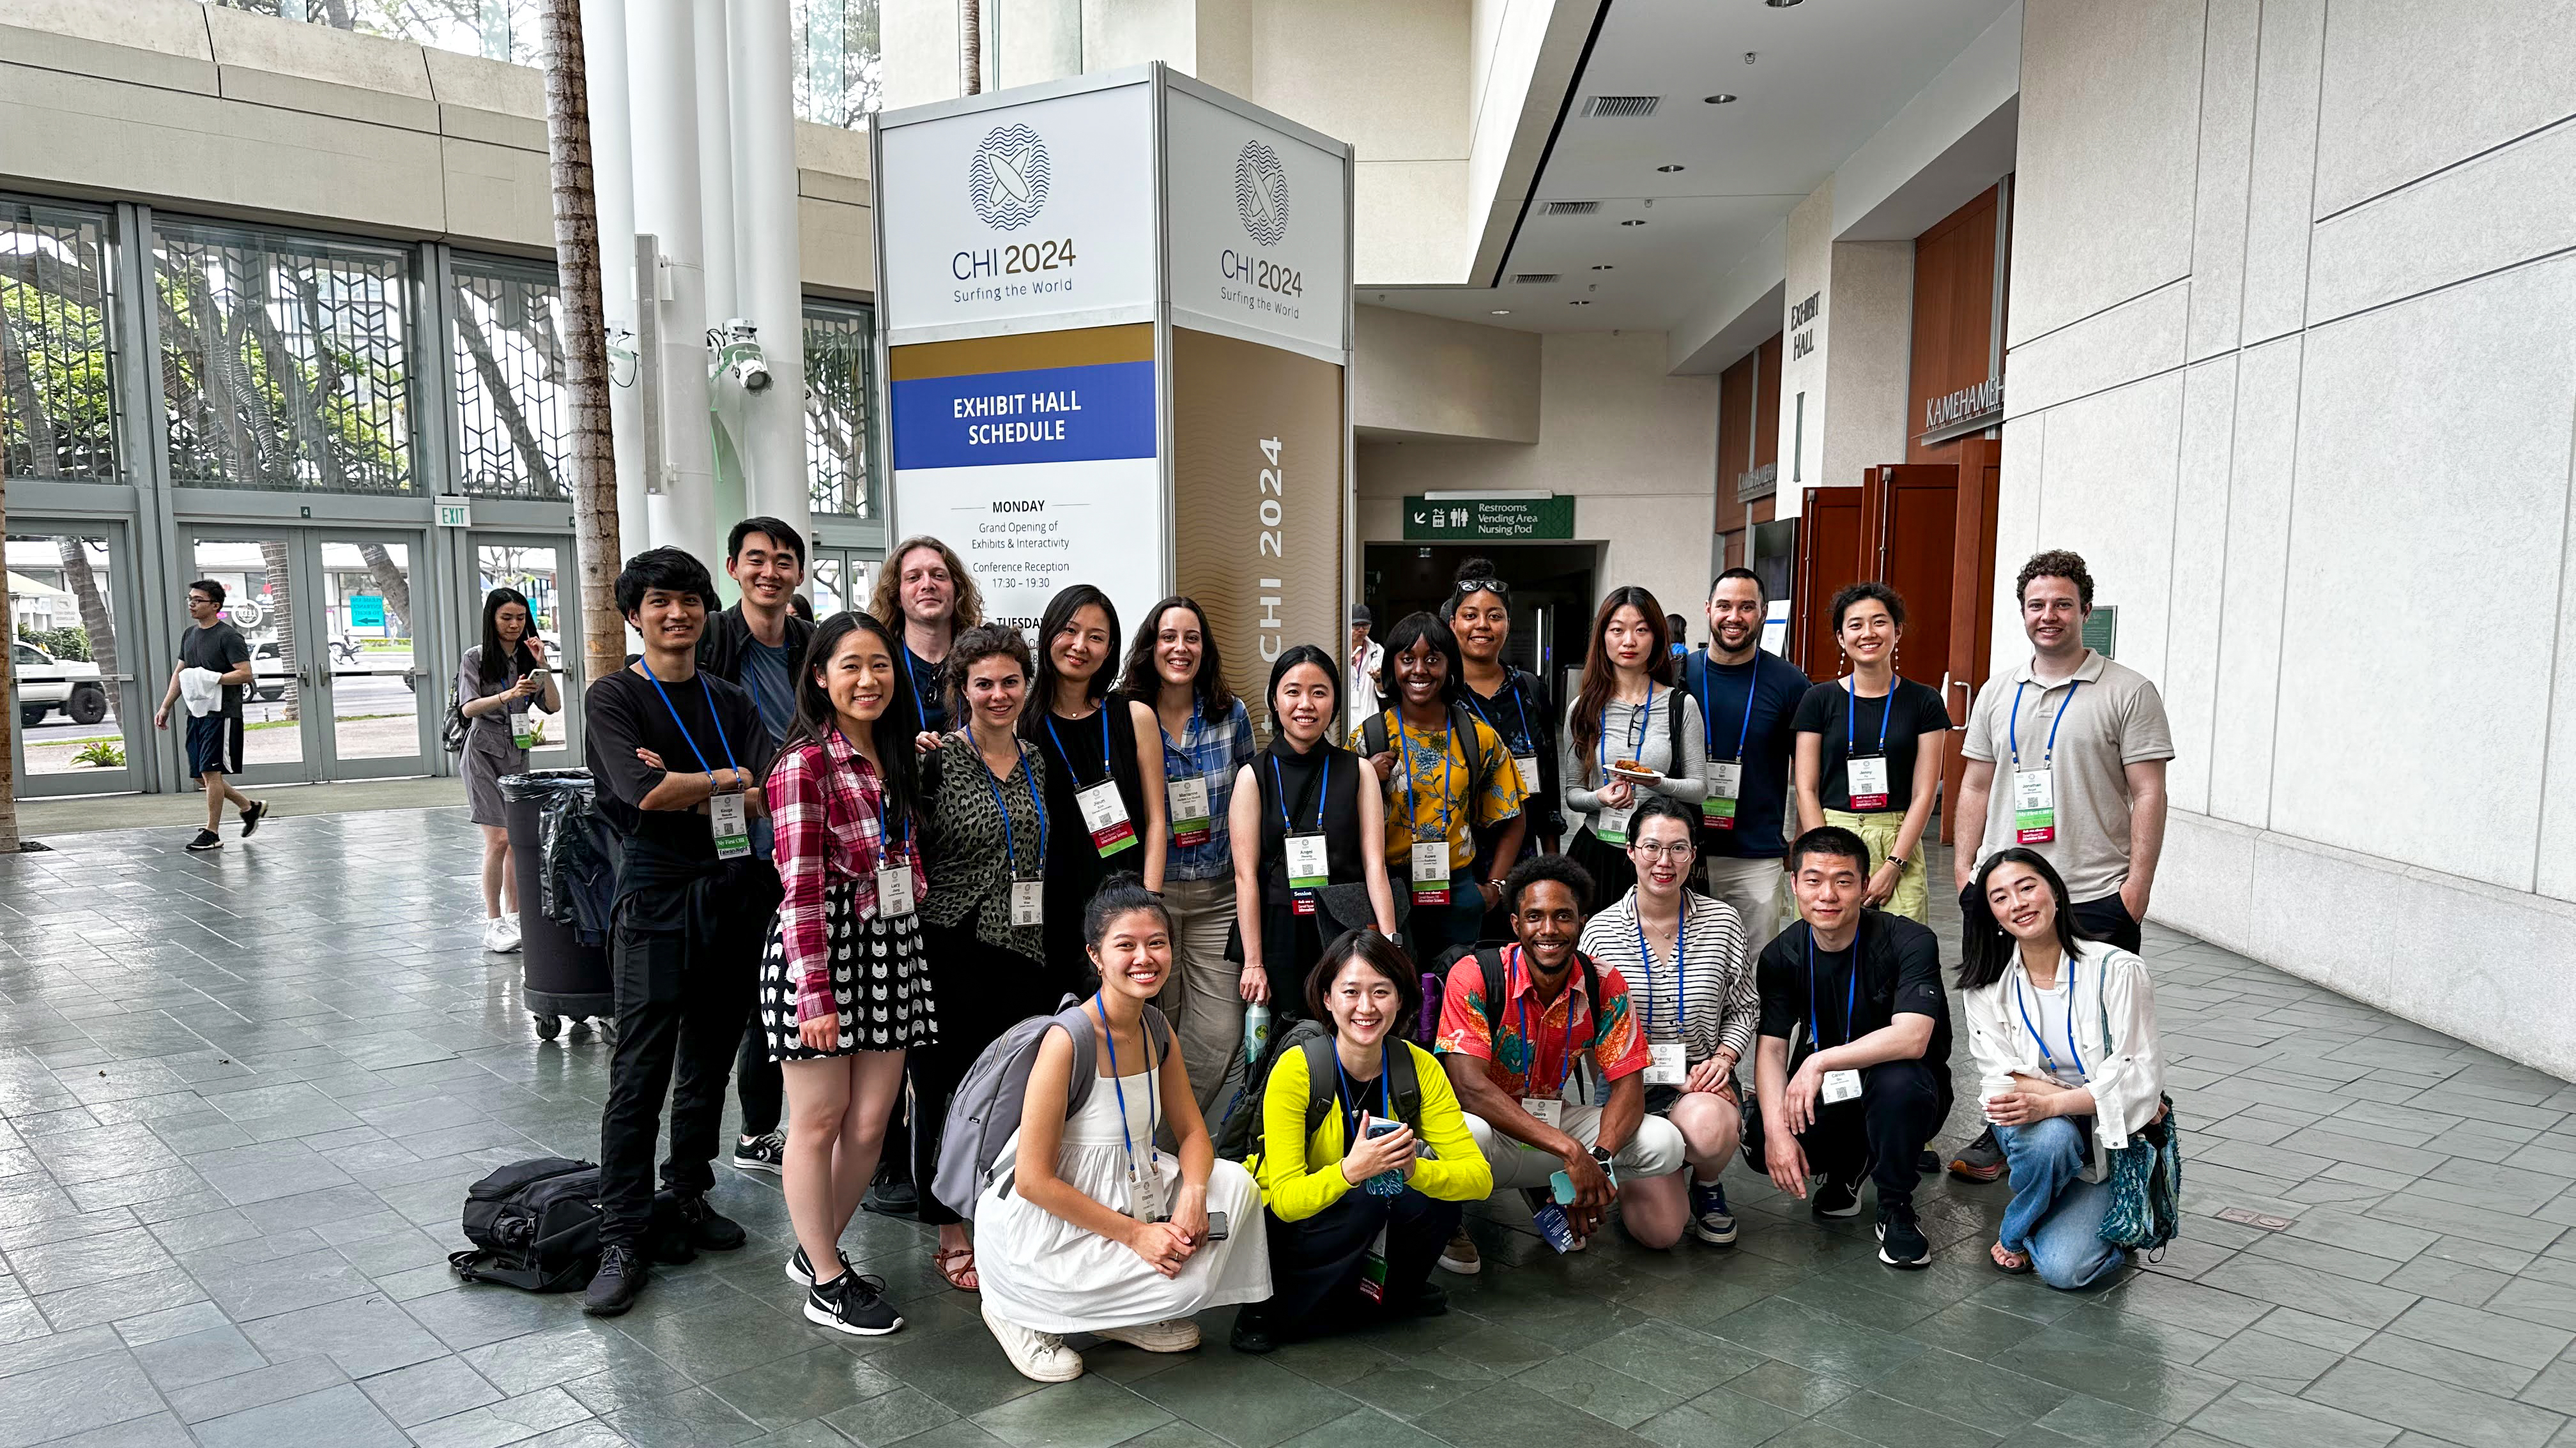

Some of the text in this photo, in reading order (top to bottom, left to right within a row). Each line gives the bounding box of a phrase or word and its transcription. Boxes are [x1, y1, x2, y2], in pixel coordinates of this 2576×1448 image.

[953, 238, 1077, 280] CHI 2024
[1222, 249, 1303, 298] CHI 2024
[954, 278, 1072, 303] Surfing the World
[1221, 286, 1299, 319] Surfing the World
[1790, 291, 1820, 332] EXHIBIT
[1793, 328, 1814, 362] HALL
[953, 390, 1082, 418] EXHIBIT HALL
[969, 420, 1065, 445] SCHEDULE
[993, 500, 1045, 513] MONDAY
[1259, 436, 1282, 558] 2024
[1478, 503, 1528, 512] Restrooms
[442, 507, 464, 524] EXIT
[1478, 514, 1538, 525] Vending Area
[979, 521, 1059, 535] Grand Opening of
[1478, 524, 1533, 536] Nursing Pod
[972, 537, 1070, 551] Exhibits & Interactivity
[973, 561, 1070, 574] Conference Reception
[992, 578, 1016, 588] 17:30
[1025, 577, 1050, 588] 19:30
[996, 617, 1043, 629] TUESDA
[1259, 579, 1281, 663] CHI
